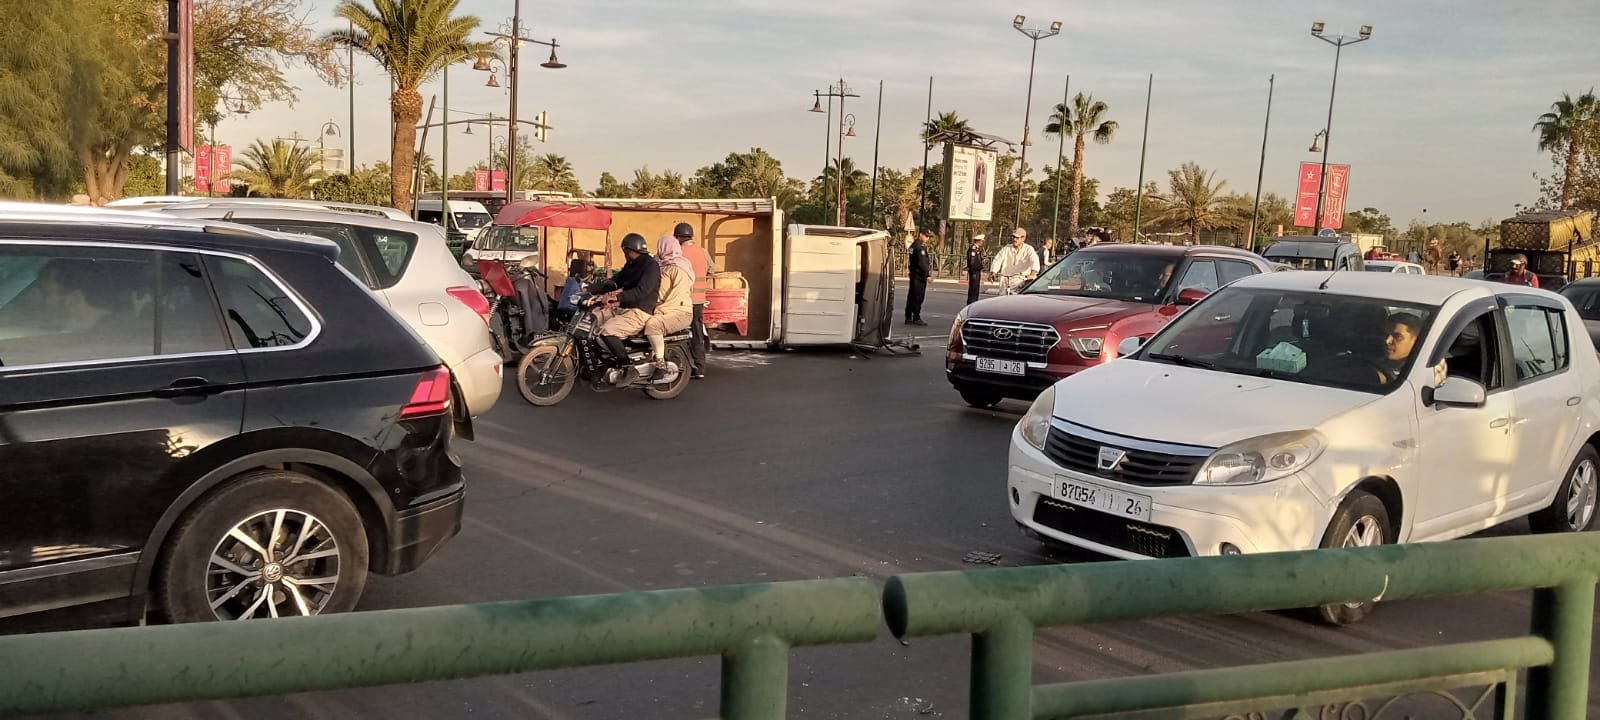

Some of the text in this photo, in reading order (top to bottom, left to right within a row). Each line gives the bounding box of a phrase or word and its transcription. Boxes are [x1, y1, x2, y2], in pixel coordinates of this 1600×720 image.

[1012, 362, 1021, 373] 26
[1061, 482, 1096, 505] 87054
[1125, 498, 1142, 515] 26
